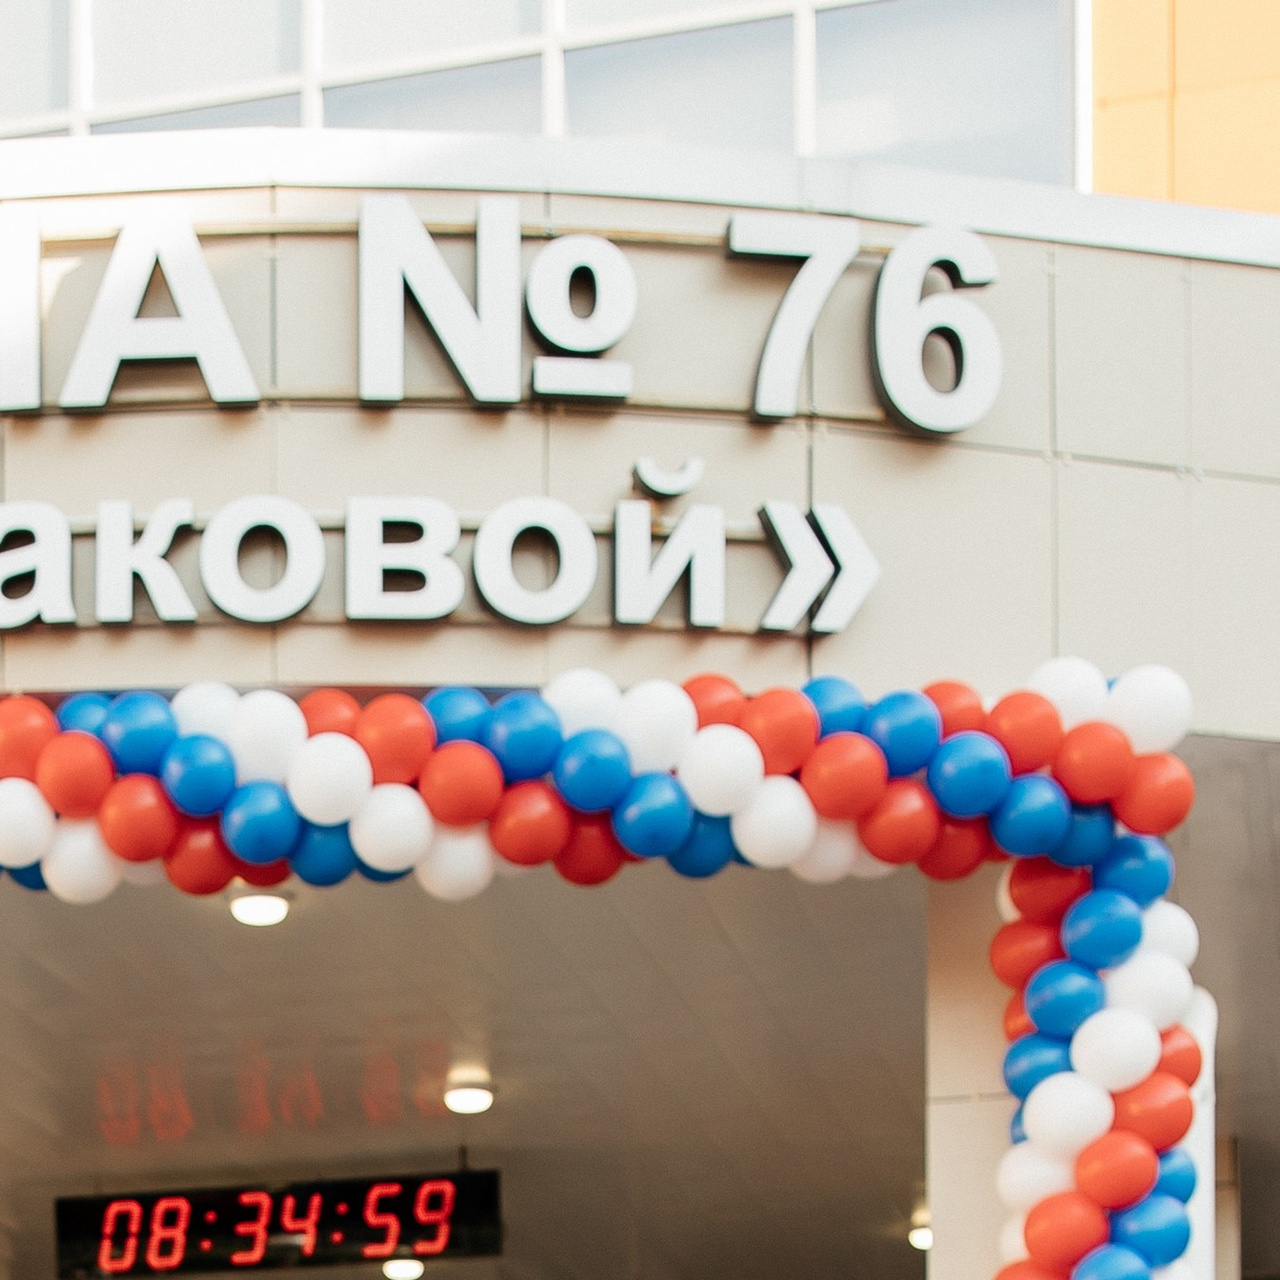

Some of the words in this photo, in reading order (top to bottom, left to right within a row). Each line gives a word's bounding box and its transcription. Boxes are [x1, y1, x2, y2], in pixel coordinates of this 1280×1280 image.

[358, 202, 638, 404] №
[726, 214, 1004, 434] 76
[97, 1178, 457, 1274] 08:34:59
